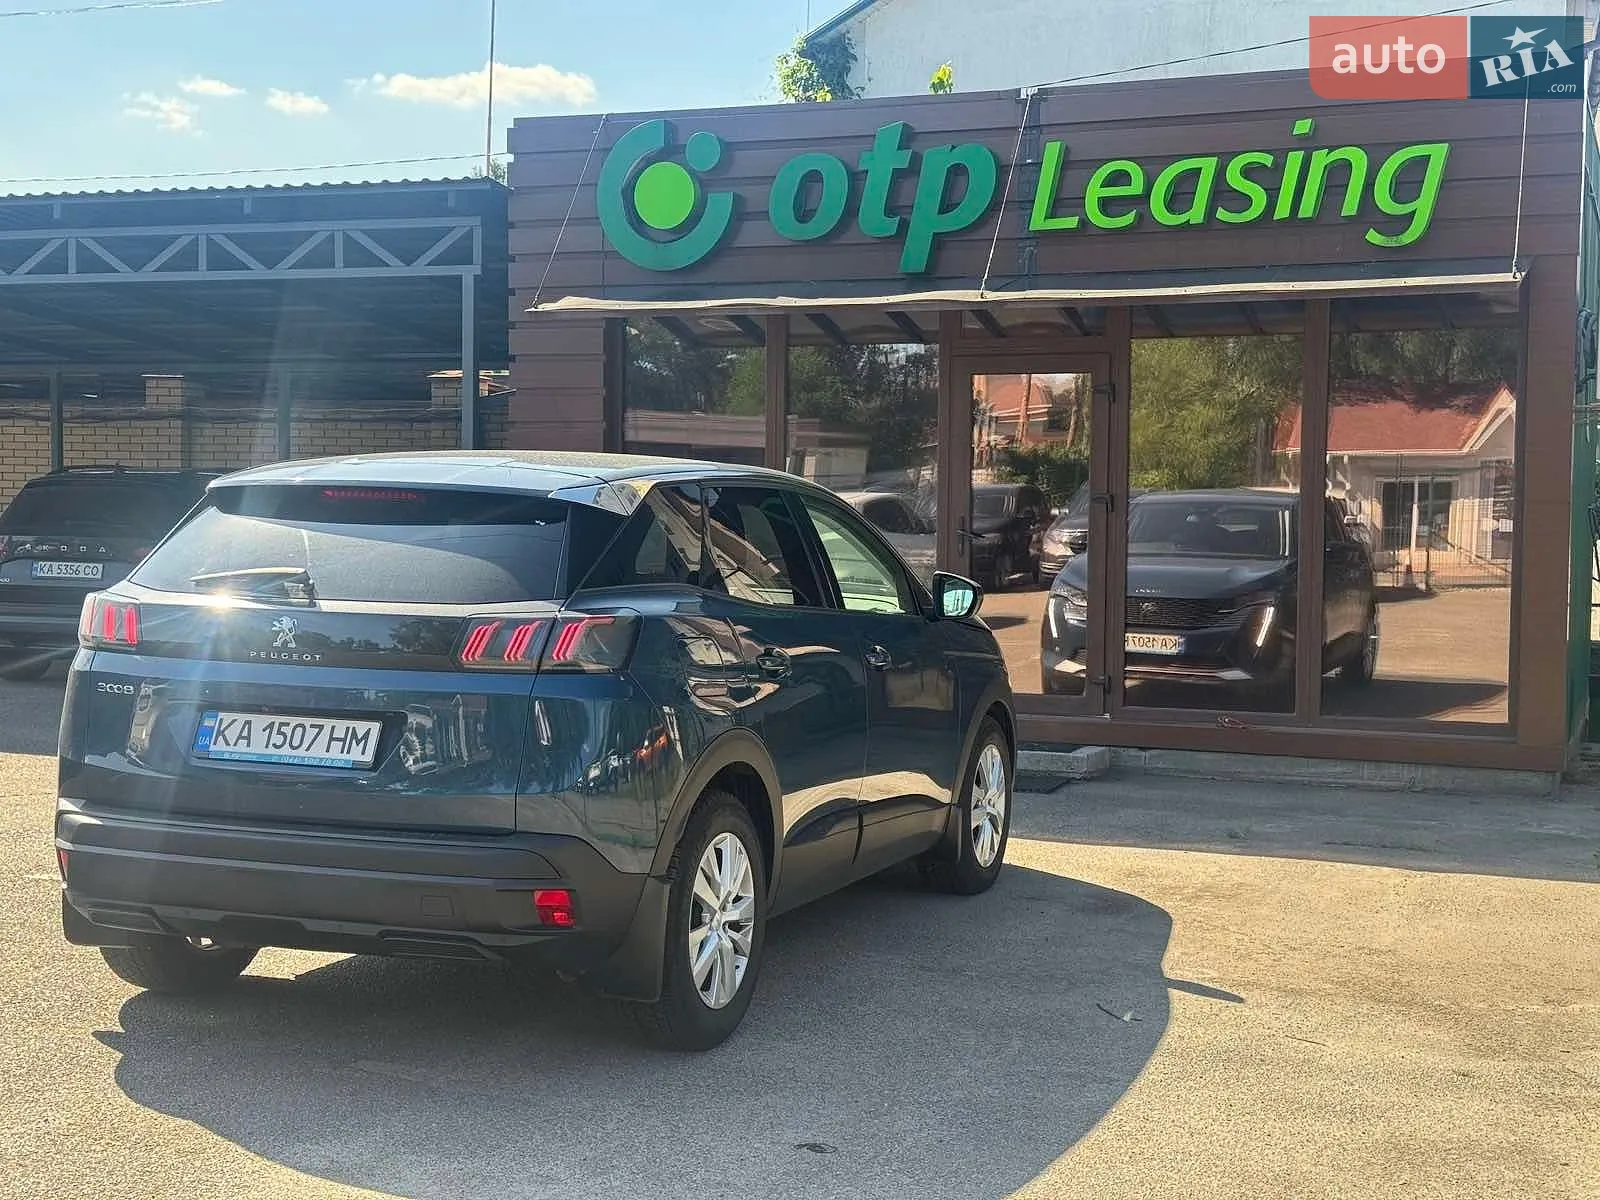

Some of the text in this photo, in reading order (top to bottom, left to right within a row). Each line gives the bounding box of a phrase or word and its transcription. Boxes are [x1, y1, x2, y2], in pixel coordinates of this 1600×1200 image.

[768, 118, 1451, 274] otp Leasing
[39, 563, 54, 575] KA
[57, 564, 81, 576] 5356
[250, 651, 321, 661] PEUGEOT
[212, 717, 372, 756] KA 1507 HM
